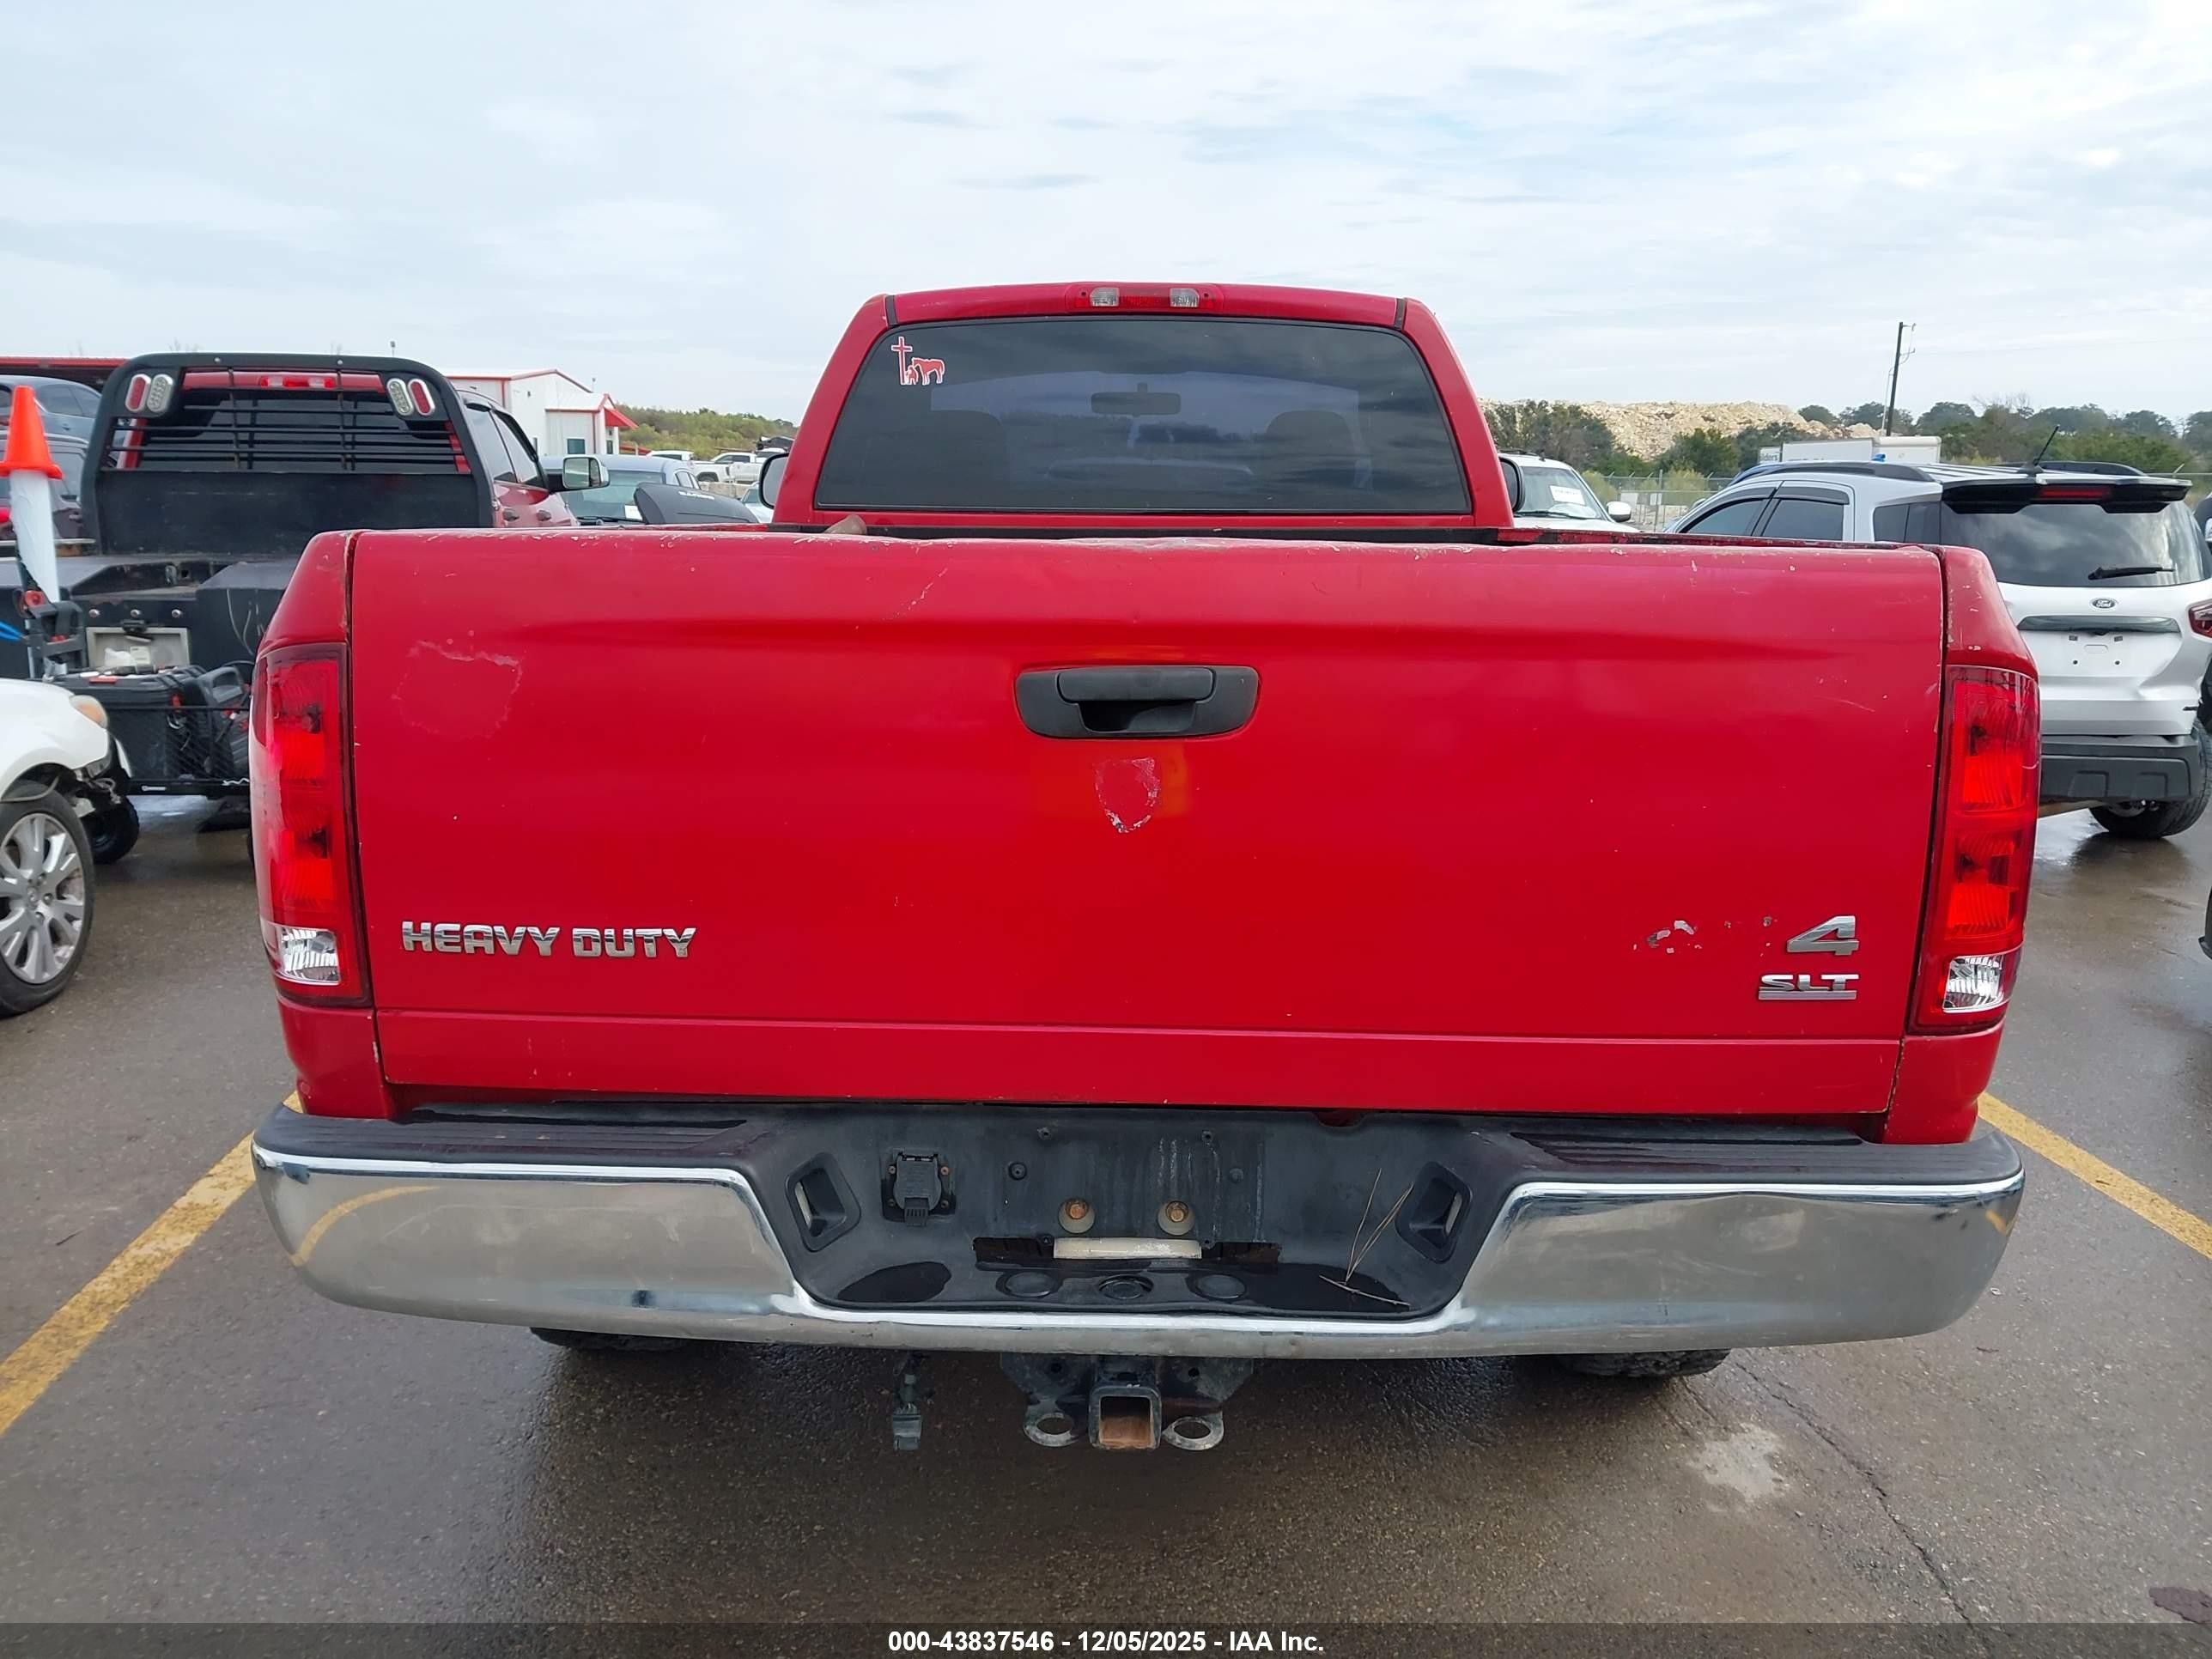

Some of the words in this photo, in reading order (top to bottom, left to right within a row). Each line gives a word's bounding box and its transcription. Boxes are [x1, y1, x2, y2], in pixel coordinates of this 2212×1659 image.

[401, 921, 560, 957] HEAVY
[572, 927, 696, 957] DUTY
[1787, 915, 1859, 955] 4
[1759, 974, 1859, 993] SLT
